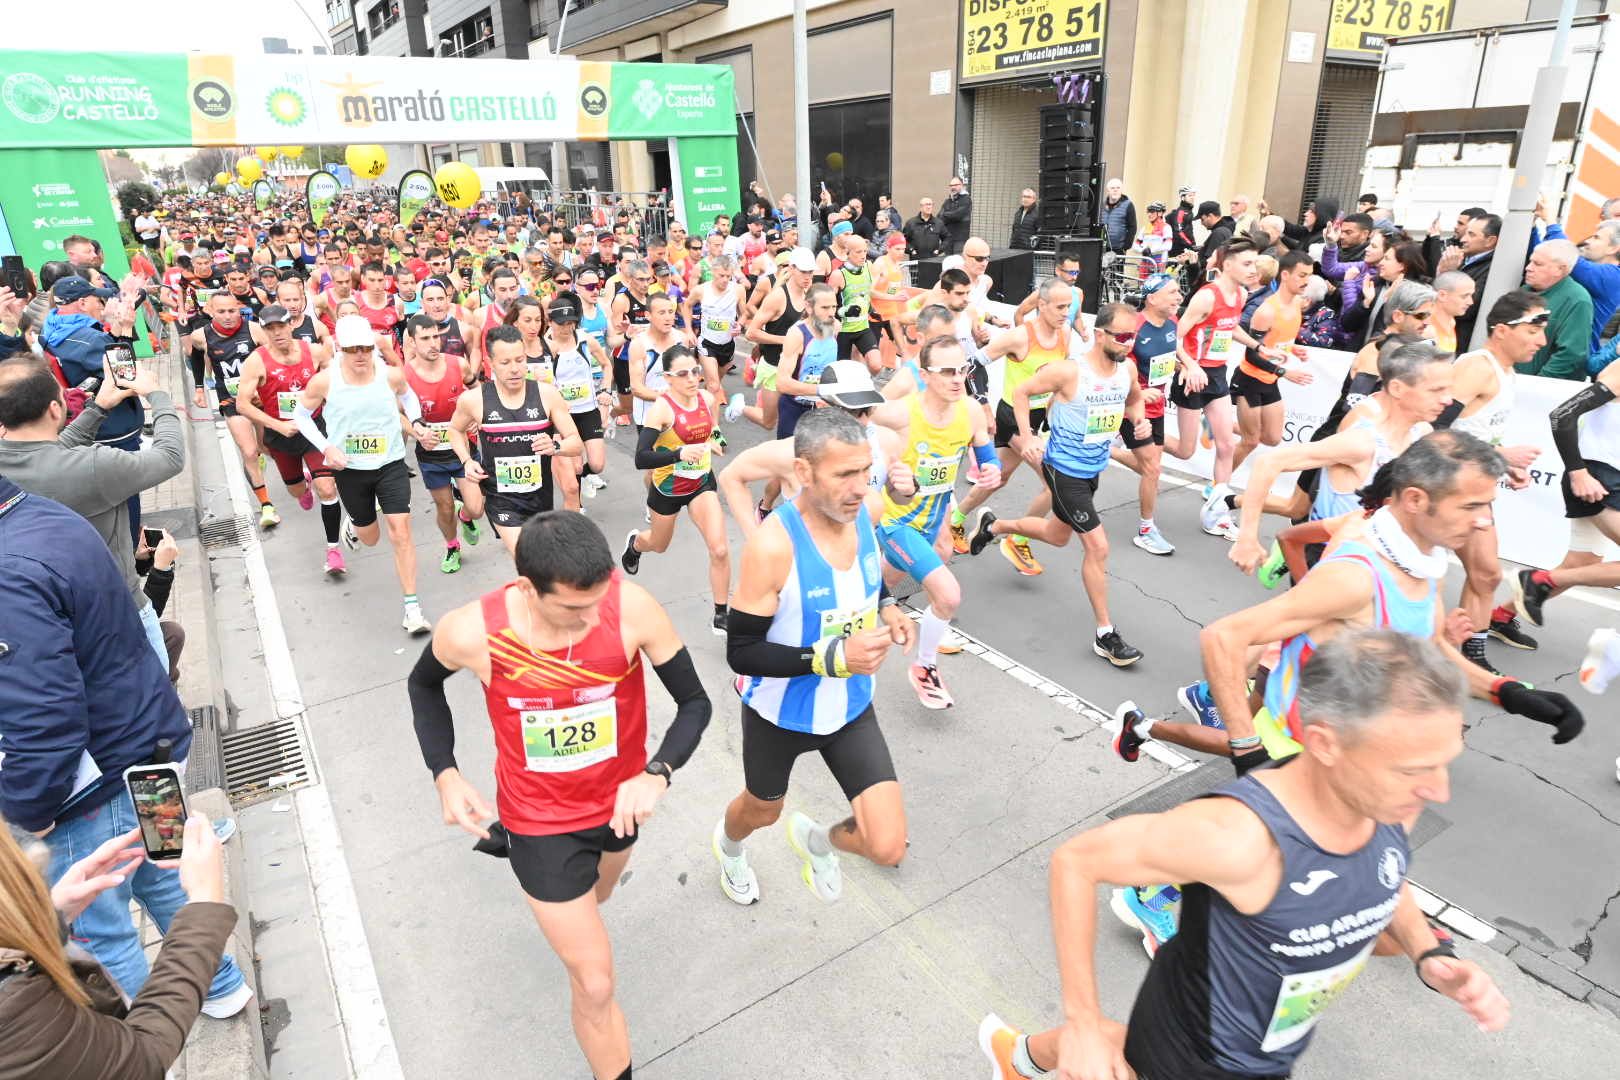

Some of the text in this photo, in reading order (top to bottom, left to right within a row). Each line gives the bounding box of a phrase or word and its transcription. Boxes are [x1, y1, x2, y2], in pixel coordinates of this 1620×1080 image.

[1006, 6, 1033, 19] 2.419
[1343, 0, 1375, 27] 23
[1384, 0, 1412, 30] 78
[1418, 4, 1446, 32] 51
[968, 3, 1101, 56] 964 23 78 51
[59, 86, 151, 103] RUNNING
[665, 91, 716, 108] Castelló
[342, 88, 557, 122] marató CASTELLÓ
[570, 386, 581, 397] 57
[1096, 414, 1115, 428] 113
[354, 438, 380, 449] 104
[507, 465, 532, 480] 103
[930, 467, 948, 481] 96
[544, 720, 597, 749] 128
[553, 745, 590, 757] ADELL
